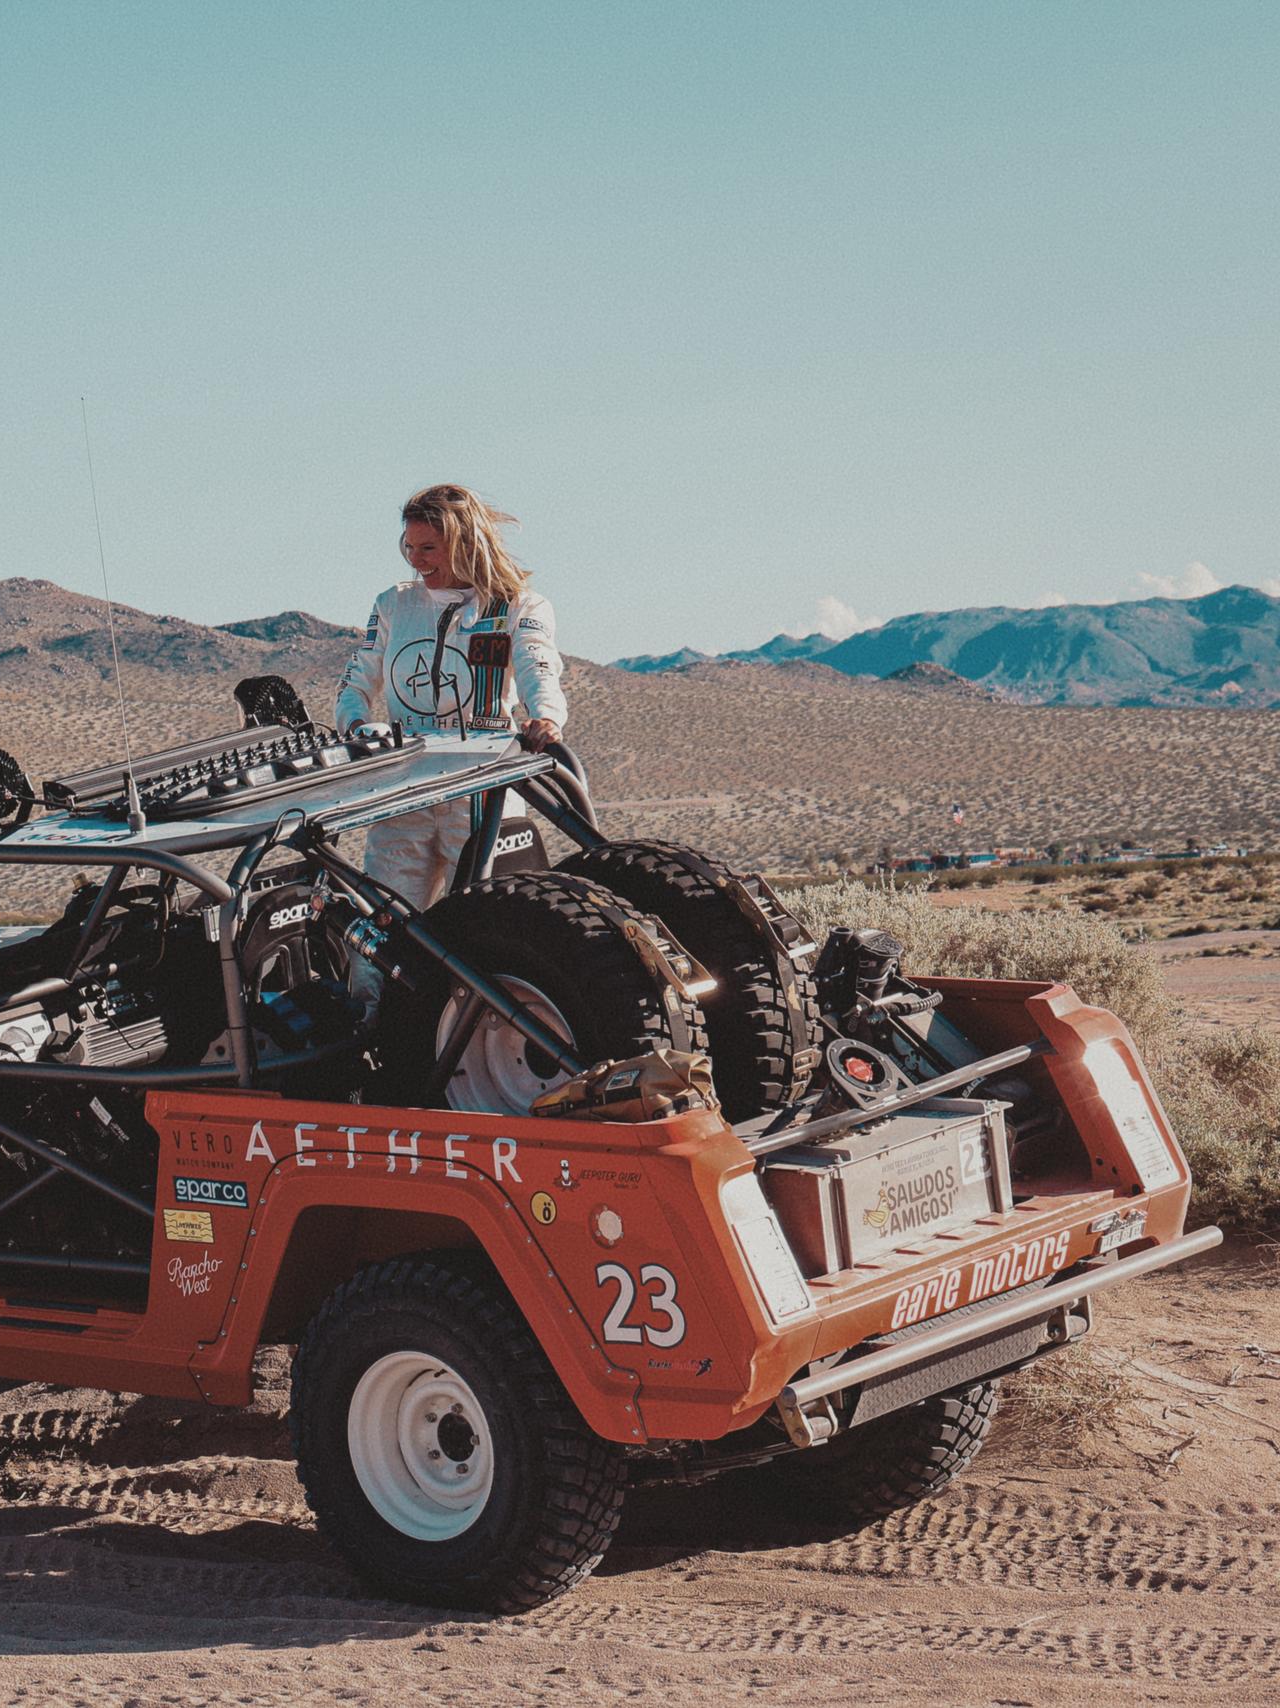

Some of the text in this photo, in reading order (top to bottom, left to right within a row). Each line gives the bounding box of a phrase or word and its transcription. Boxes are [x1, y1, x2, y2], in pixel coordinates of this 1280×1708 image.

[494, 829, 533, 857] parco
[269, 902, 313, 928] spar
[172, 1130, 233, 1154] VERO
[245, 1120, 523, 1183] AETHER
[176, 1179, 247, 1201] sparco
[167, 1250, 224, 1282] Rancho
[890, 1266, 962, 1330] earle
[969, 1230, 1071, 1302] motors
[176, 1275, 213, 1297] West
[594, 1260, 687, 1348] 23
